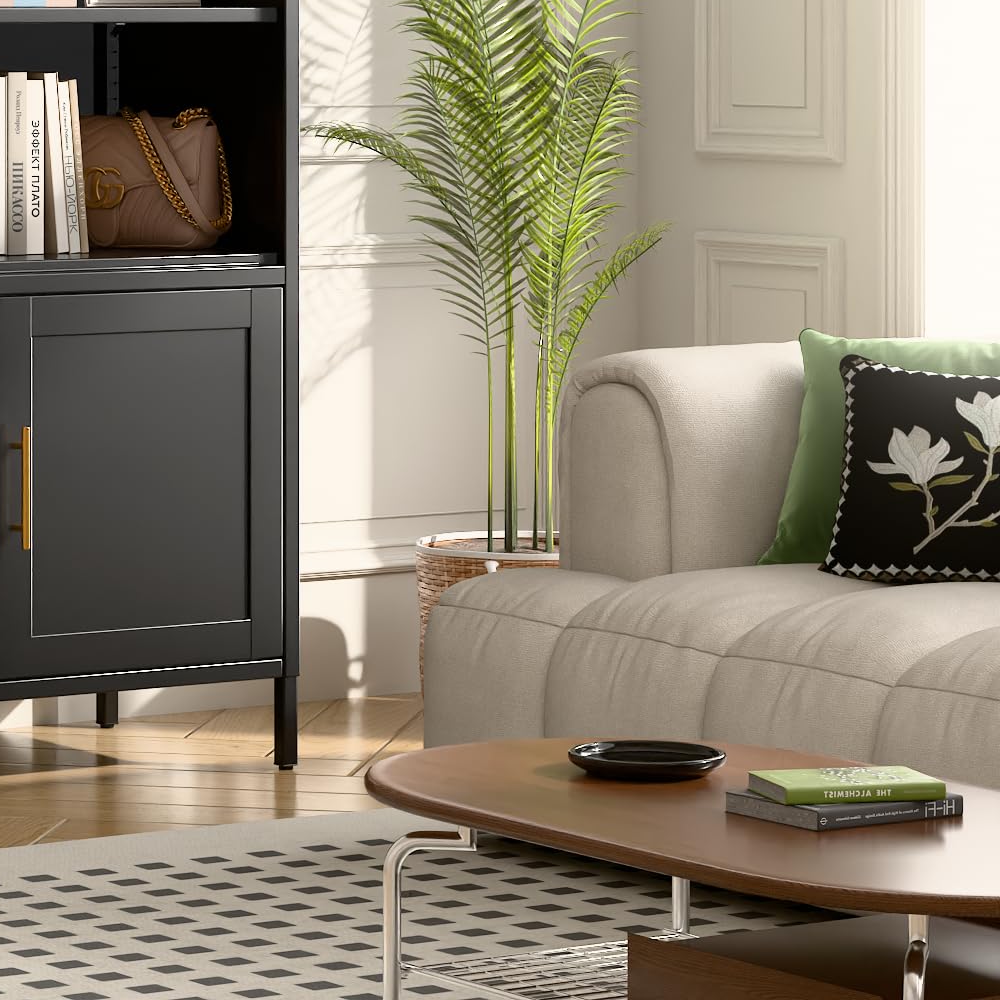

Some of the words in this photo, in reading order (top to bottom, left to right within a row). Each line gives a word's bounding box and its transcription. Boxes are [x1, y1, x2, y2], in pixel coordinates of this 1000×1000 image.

[31, 120, 40, 171] ЭФФЕКТ
[12, 162, 24, 233] ПИКАССО
[31, 175, 40, 218] ПЛАТО
[64, 155, 78, 234] НЬЮ-ЙОРК
